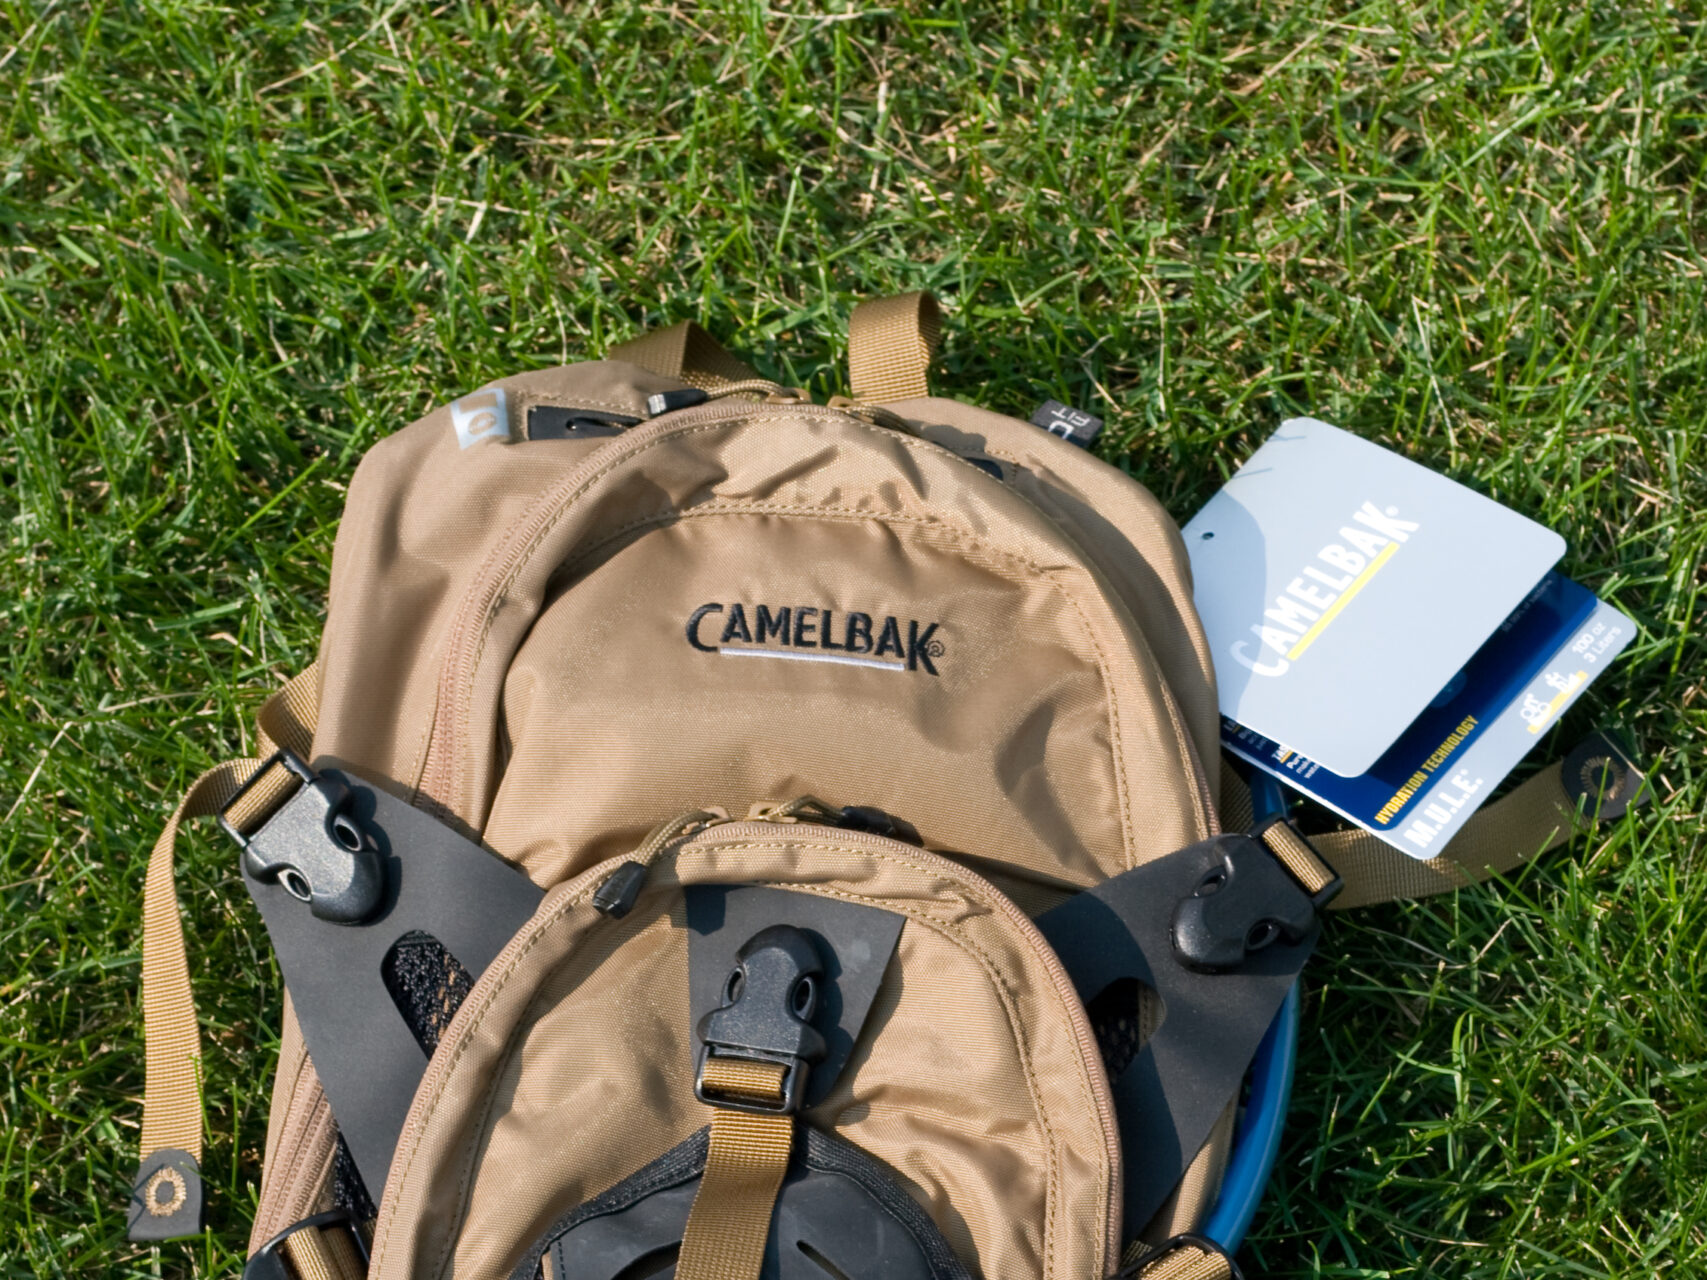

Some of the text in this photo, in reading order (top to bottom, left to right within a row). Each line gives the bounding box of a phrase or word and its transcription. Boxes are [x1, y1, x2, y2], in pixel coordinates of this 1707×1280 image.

[1050, 407, 1090, 427] FIT
[1229, 501, 1420, 677] CAMELBAK
[686, 603, 940, 676] CAMELBAK
[1572, 633, 1595, 654] 100
[1583, 652, 1597, 663] 3
[1374, 715, 1479, 825] HYDRATION TECHNOLOGY
[1403, 773, 1484, 848] M.U.L.E.
